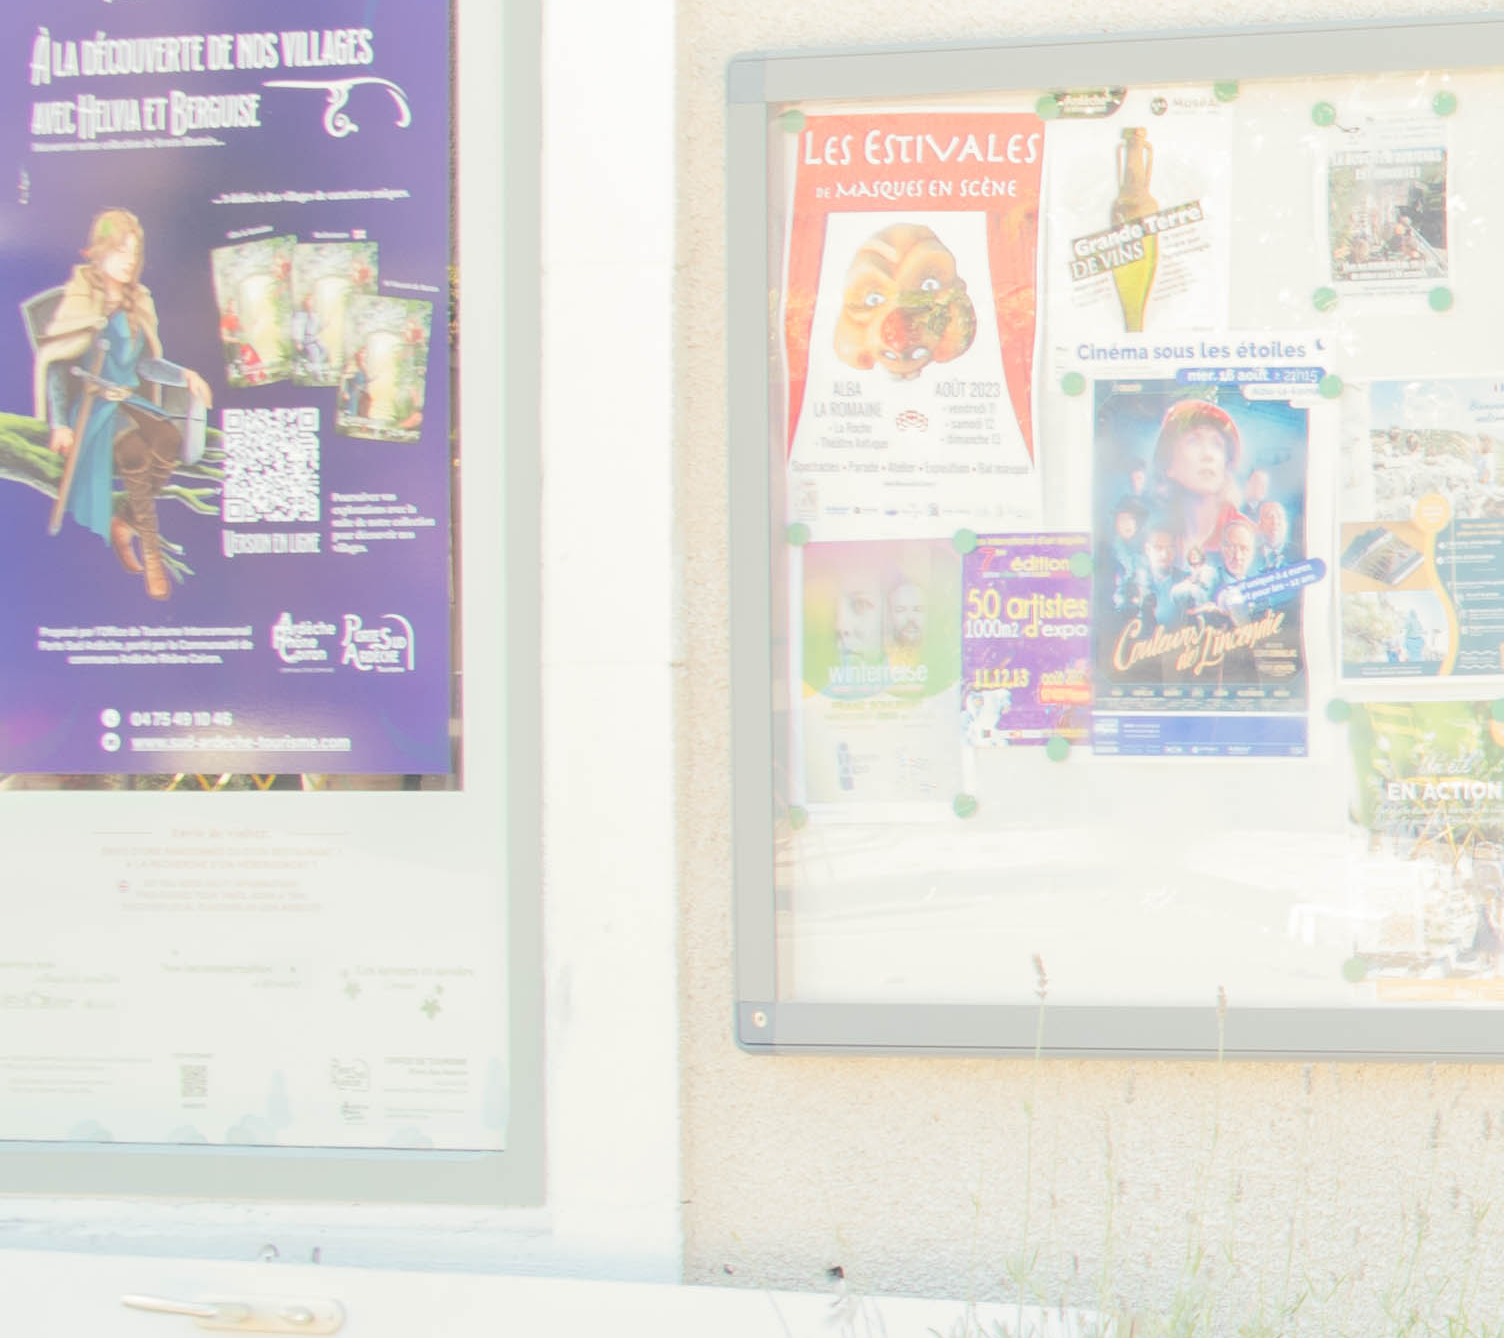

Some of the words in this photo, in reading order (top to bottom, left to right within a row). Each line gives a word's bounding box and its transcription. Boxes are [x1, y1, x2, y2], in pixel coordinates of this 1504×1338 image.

[53, 40, 81, 77] LA
[82, 30, 206, 76] DÉCOUVERTE
[208, 34, 235, 71] DE
[237, 32, 280, 69] NOS
[281, 28, 375, 67] VILLAGES
[143, 97, 169, 132] ET
[806, 131, 854, 165] LES
[865, 129, 1041, 164] ESTIVALES
[835, 179, 924, 201] MASQUES
[929, 179, 953, 197] EN
[960, 177, 1018, 197] SCÈNE
[1073, 221, 1145, 258] Grande
[1142, 206, 1202, 234] Terre
[1071, 258, 1099, 280] DE
[1099, 241, 1146, 270] VINS
[1077, 343, 1149, 360] Cinéma
[1153, 345, 1195, 360] sous
[1201, 341, 1231, 359] les
[1236, 340, 1307, 359] étoiles
[966, 588, 1000, 619] 50
[1006, 592, 1089, 619] artistes
[1387, 781, 1417, 800] EN
[1421, 780, 1504, 800] ACTION
